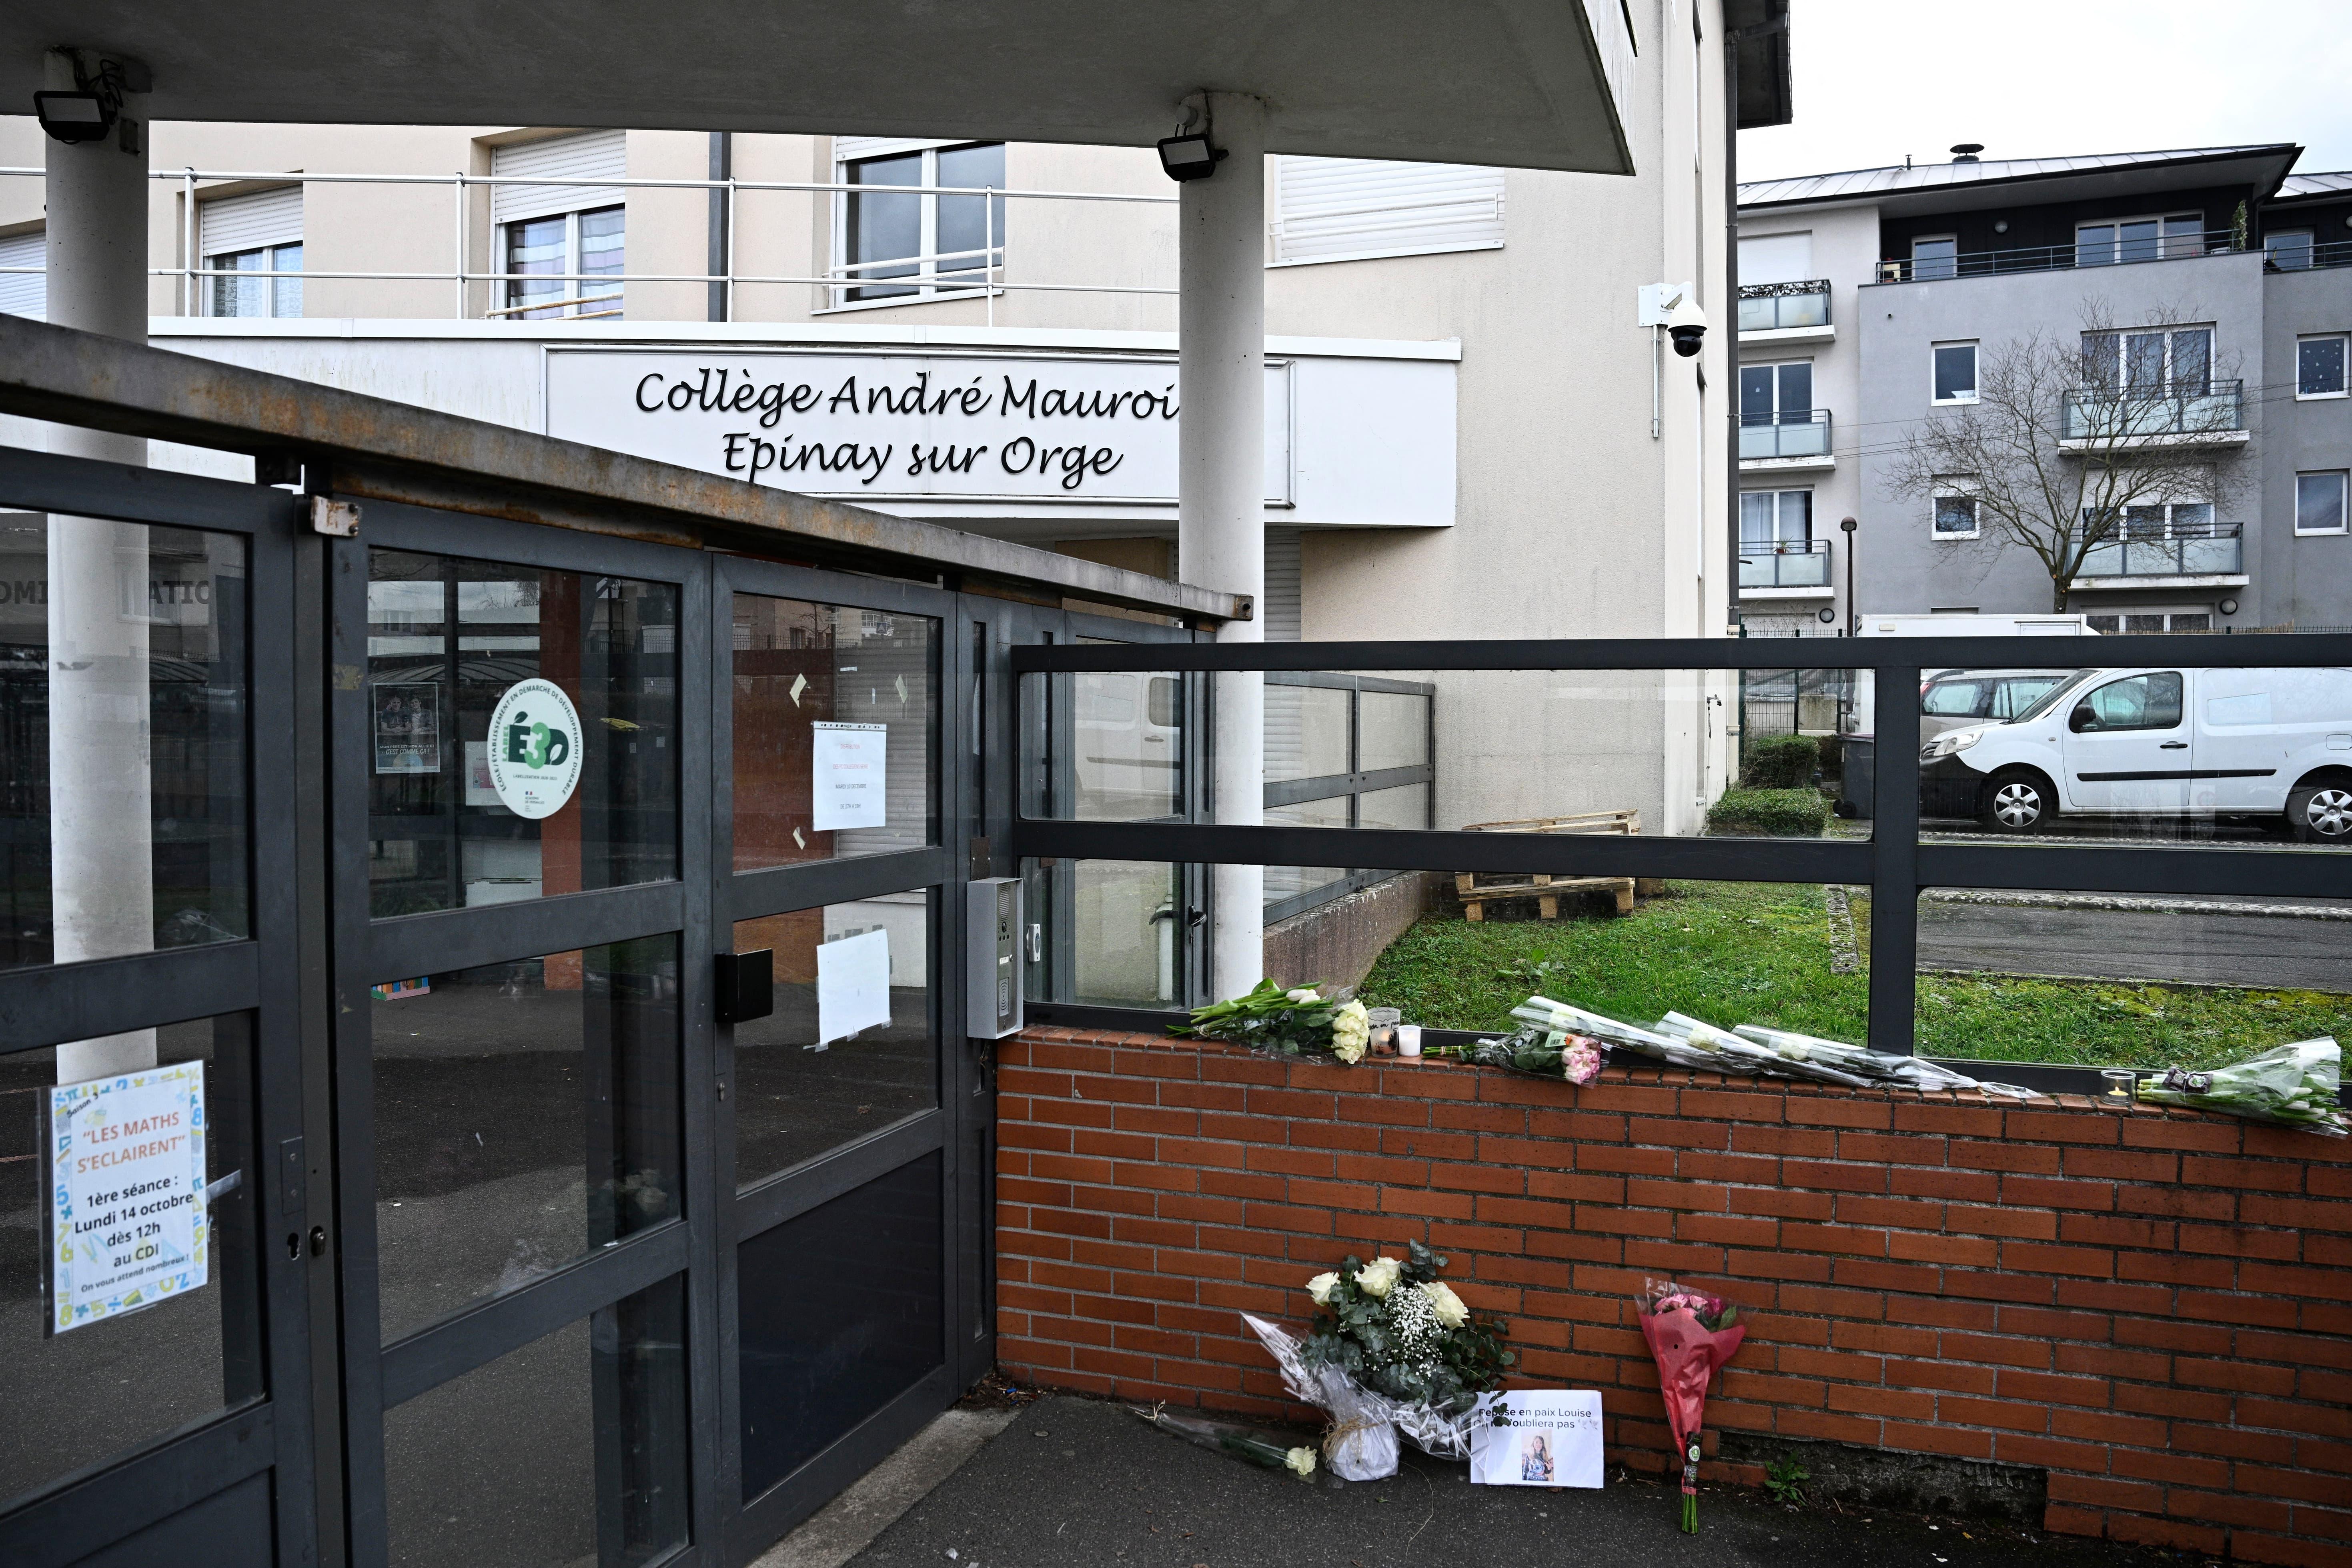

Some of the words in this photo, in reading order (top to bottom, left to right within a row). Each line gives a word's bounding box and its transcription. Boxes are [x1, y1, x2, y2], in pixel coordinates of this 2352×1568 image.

[635, 368, 823, 428] Collège
[828, 371, 993, 415] André
[1000, 374, 1180, 419] Mauroi
[722, 432, 893, 485] Epinay
[908, 443, 988, 476] sur
[1001, 436, 1124, 490] Orge
[510, 692, 518, 702] EN
[551, 690, 559, 700] DE
[562, 762, 577, 795] DURABLE
[67, 1099, 91, 1118] Saison
[124, 1111, 180, 1137] MATHS
[87, 1191, 118, 1208] 1ère
[122, 1178, 170, 1199] séance
[75, 1211, 116, 1234] Lundi
[120, 1207, 136, 1221] 14
[140, 1193, 194, 1216] octobre
[107, 1231, 131, 1247] dès
[136, 1222, 160, 1239] 12h
[114, 1254, 131, 1268] au
[135, 1243, 159, 1260] CDI
[81, 1283, 94, 1293] On
[95, 1276, 115, 1287] vous
[117, 1268, 144, 1282] attend
[145, 1256, 185, 1273] nombreux
[1507, 1418, 1554, 1428] 'oubliera
[1557, 1421, 1575, 1430] pas
[1535, 1408, 1556, 1419] paix
[1559, 1408, 1591, 1417] Louise
